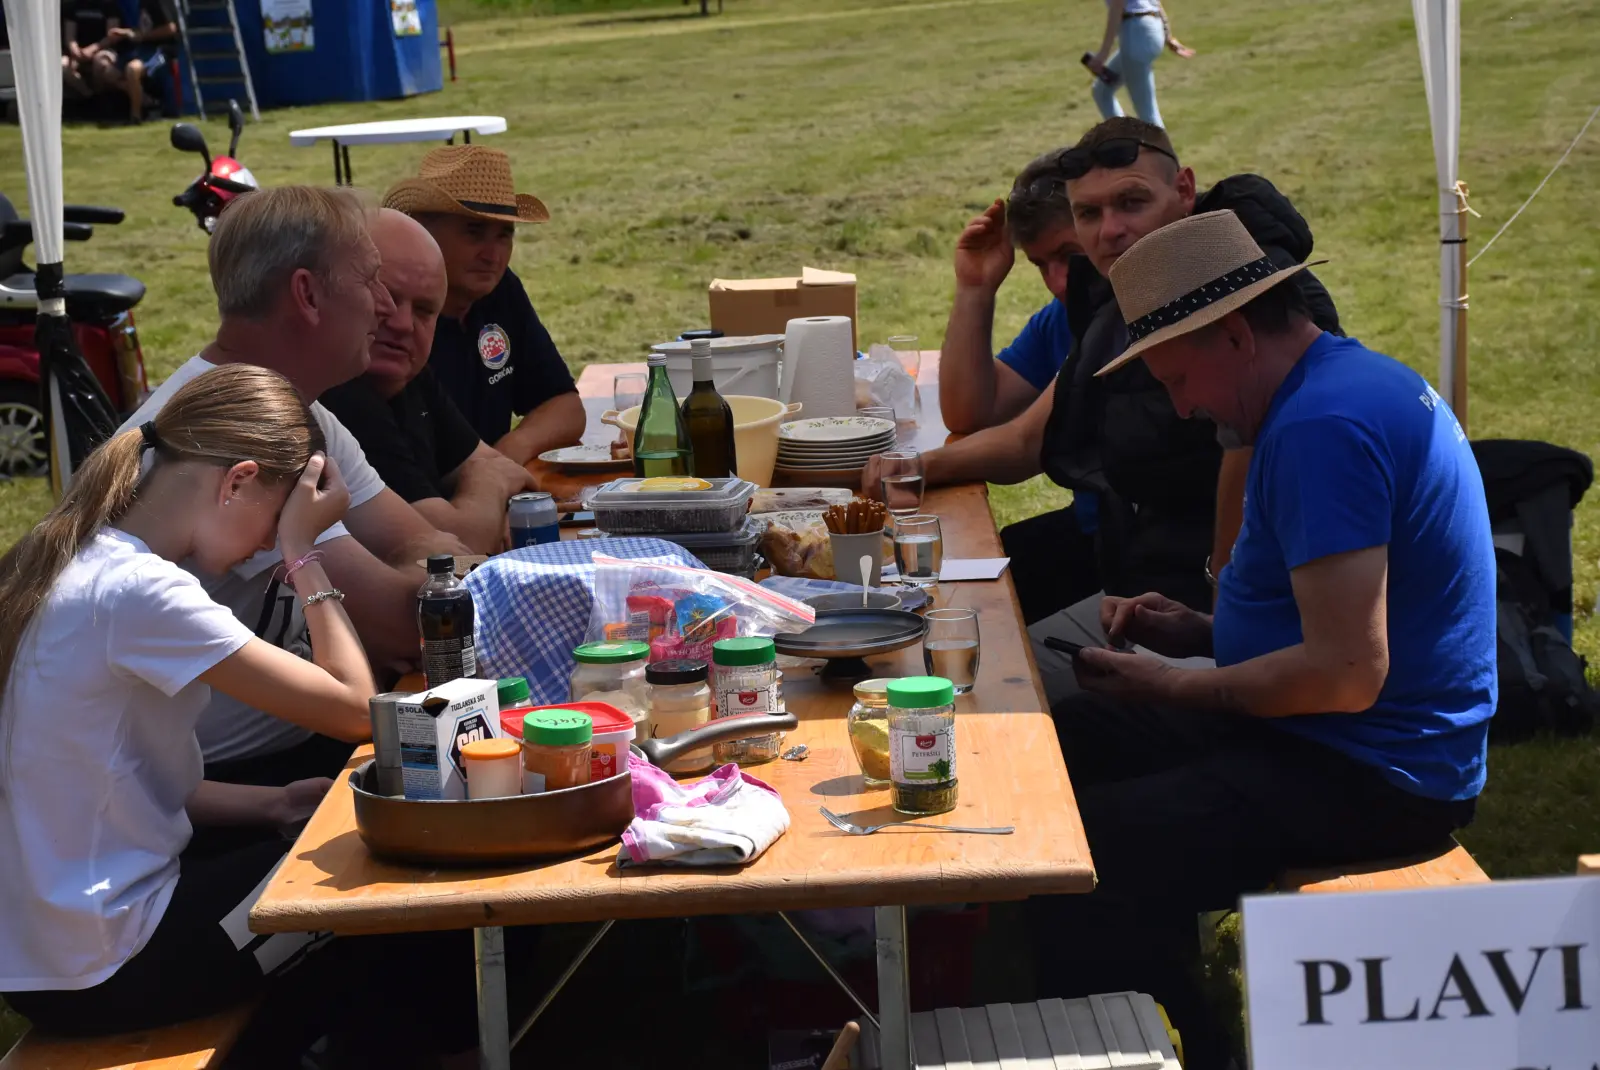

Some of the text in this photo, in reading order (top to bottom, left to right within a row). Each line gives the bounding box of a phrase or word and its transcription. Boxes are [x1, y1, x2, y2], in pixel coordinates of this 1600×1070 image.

[450, 693, 486, 712] TUZLANSKA SOL
[1295, 942, 1593, 1027] PLAVI
